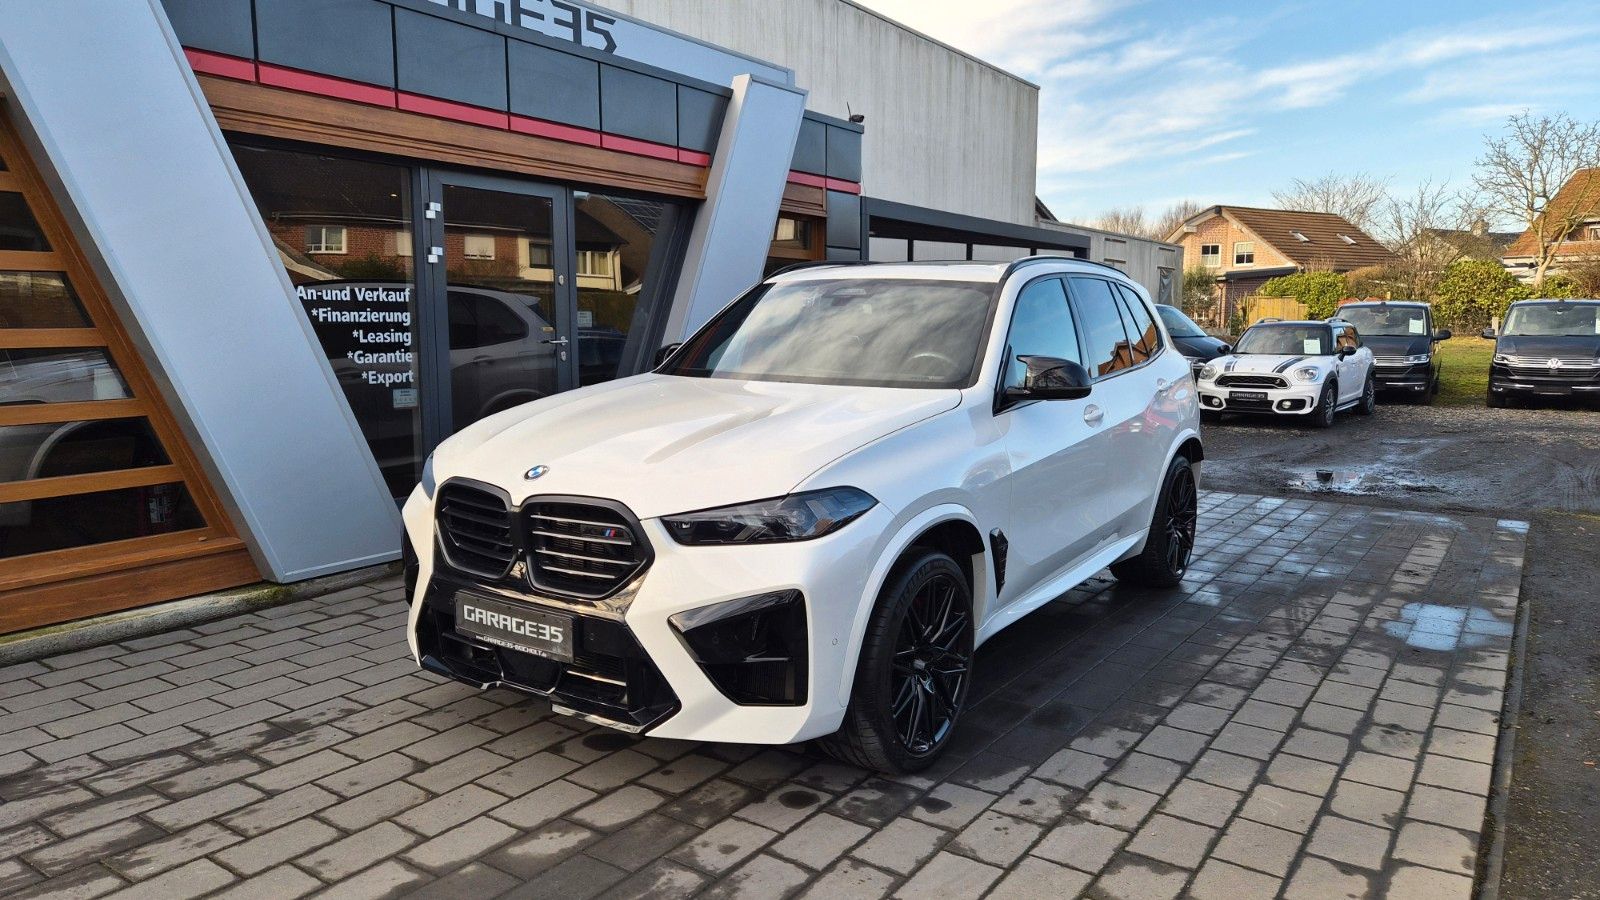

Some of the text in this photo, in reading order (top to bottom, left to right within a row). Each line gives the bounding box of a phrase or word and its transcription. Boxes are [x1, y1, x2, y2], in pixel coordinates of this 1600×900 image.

[447, 0, 617, 54] E35
[297, 286, 410, 302] An-und Verkauf
[463, 604, 563, 643] GARAGE35
